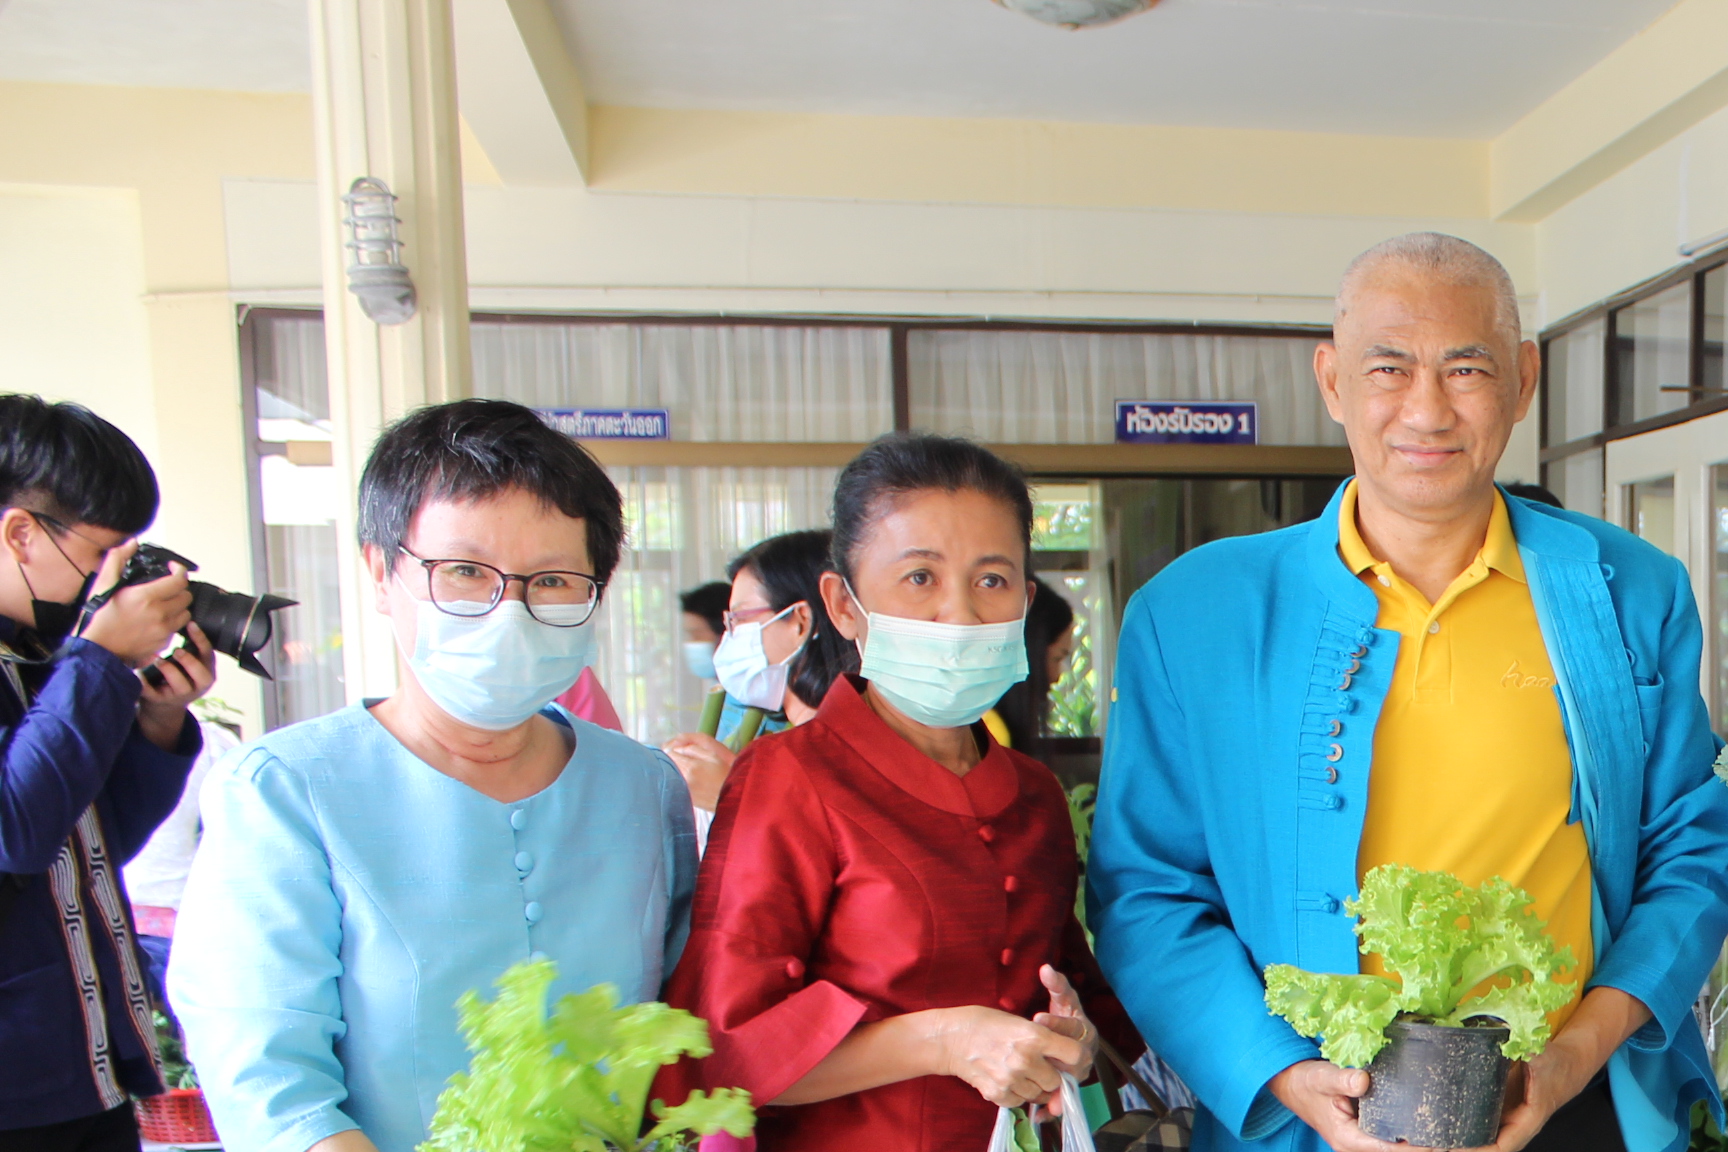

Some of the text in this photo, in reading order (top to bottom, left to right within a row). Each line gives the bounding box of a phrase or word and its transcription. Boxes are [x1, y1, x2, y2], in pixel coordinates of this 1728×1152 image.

[1126, 404, 1251, 434] ห้องรับรอง 1
